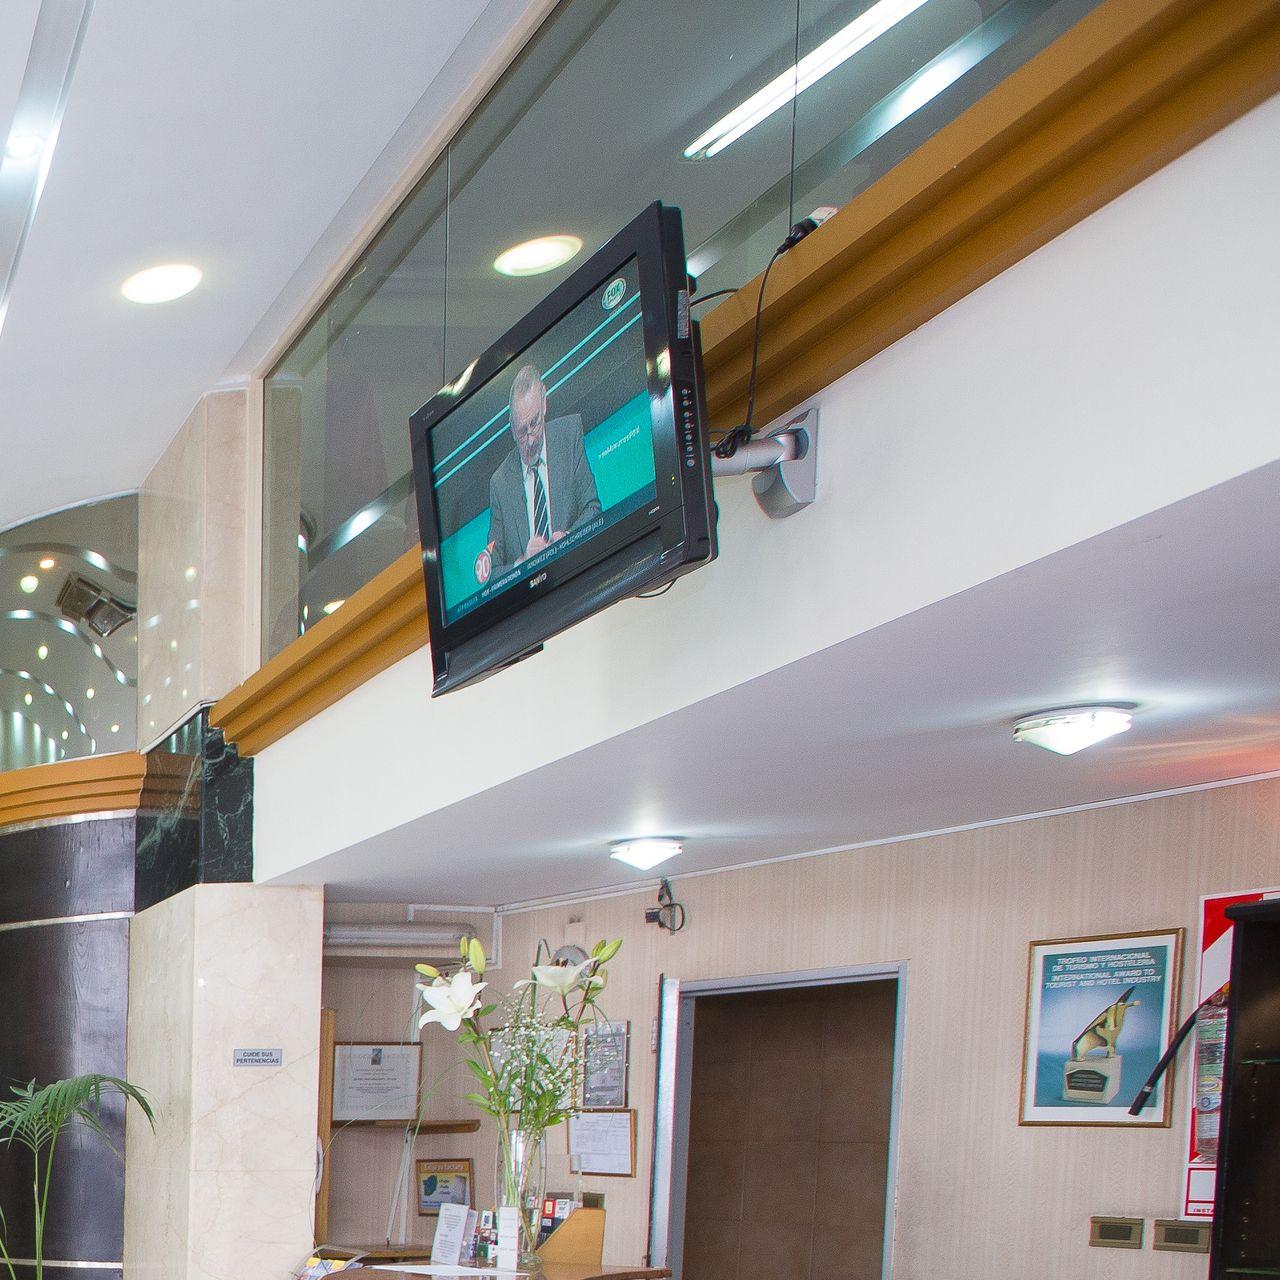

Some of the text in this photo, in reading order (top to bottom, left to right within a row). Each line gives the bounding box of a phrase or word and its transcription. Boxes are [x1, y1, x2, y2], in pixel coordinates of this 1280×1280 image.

[529, 572, 548, 589] SANYO
[1058, 951, 1151, 965] TROFEO INTERNACIONAL
[1066, 962, 1099, 971] TURISMO
[1045, 975, 1162, 989] TOURIST AND HOTEL INDUSTRY
[1051, 968, 1155, 982] INTERNATIONAL AWARD TO
